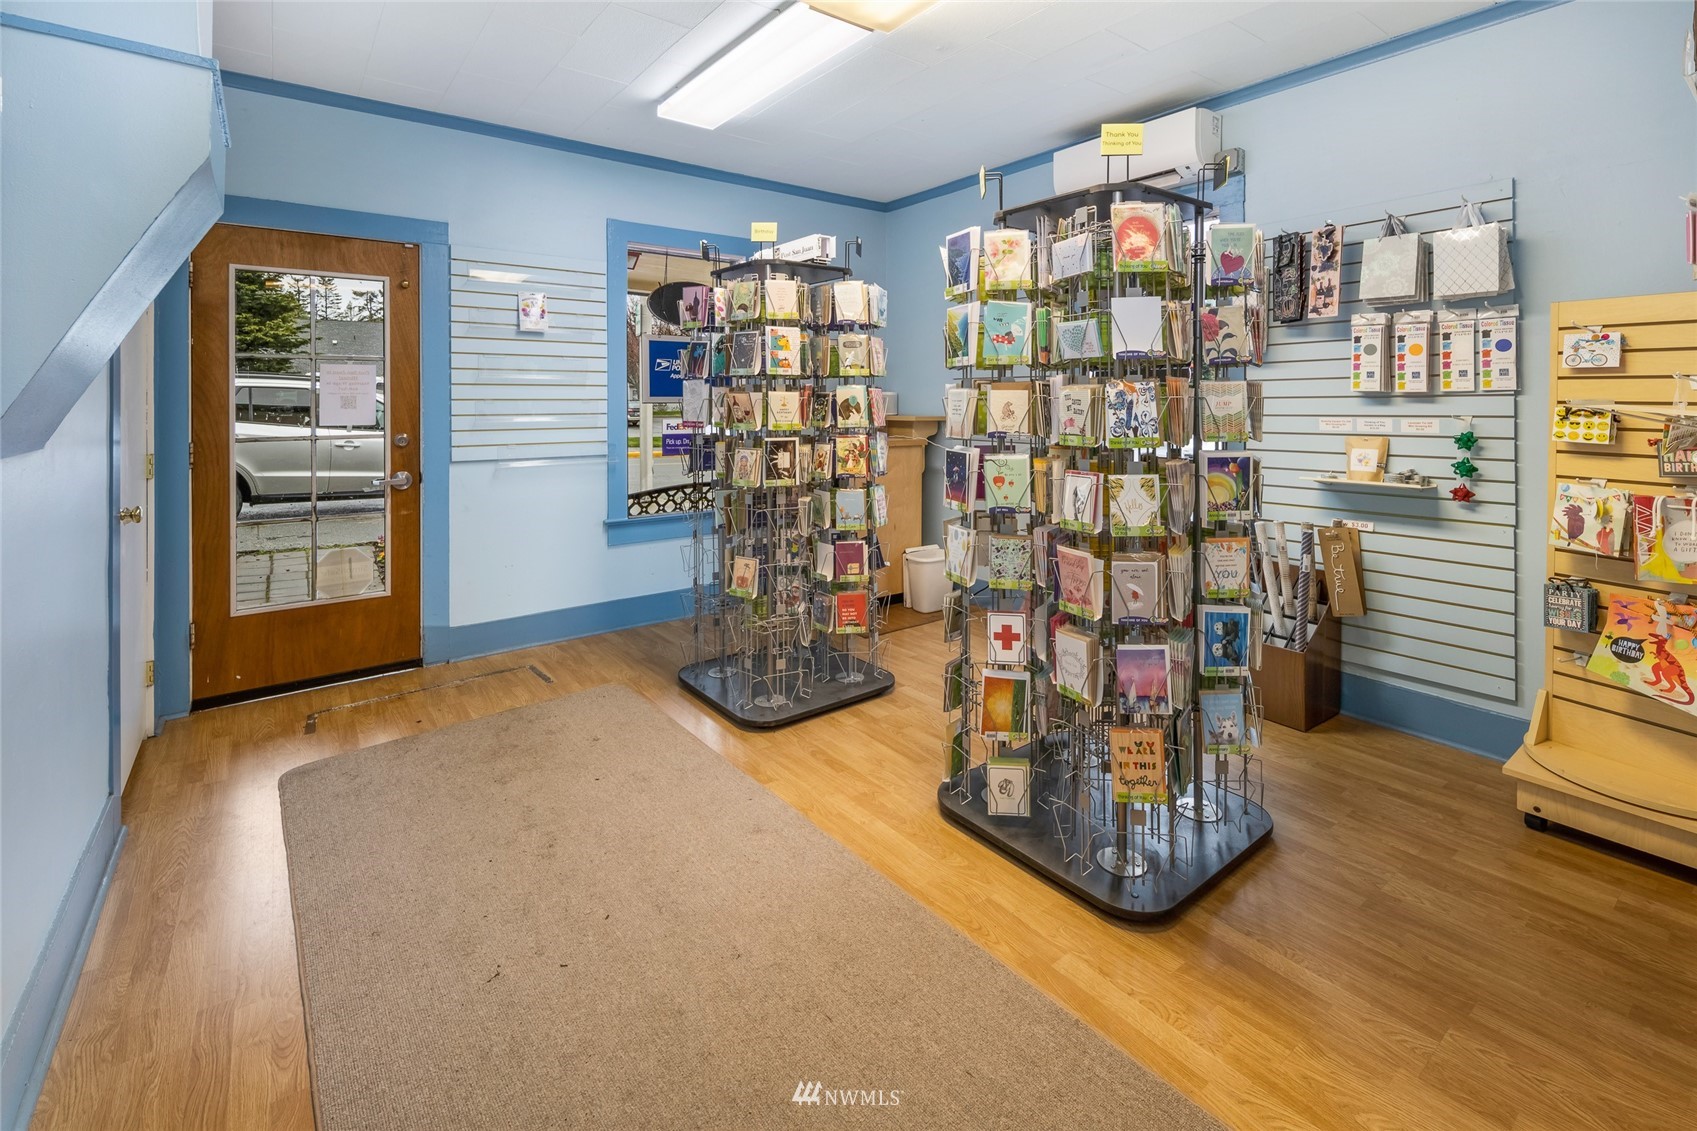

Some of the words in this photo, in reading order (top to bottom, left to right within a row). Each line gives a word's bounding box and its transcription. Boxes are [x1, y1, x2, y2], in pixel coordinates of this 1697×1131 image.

[1352, 521, 1368, 529] $3.00
[1331, 542, 1345, 559] Be
[1215, 569, 1238, 578] YOU
[1333, 563, 1346, 611] true
[1549, 589, 1582, 598] PARTY
[1548, 597, 1582, 607] CELEBRATE
[1549, 609, 1582, 620] WISHES
[1549, 616, 1566, 626] YOUR
[1567, 620, 1581, 628] DAY
[1618, 639, 1640, 650] HAPPY
[1611, 644, 1643, 660] BIRTHDAY
[1119, 746, 1133, 754] WE
[1133, 762, 1156, 770] THIS
[1119, 775, 1158, 790] together
